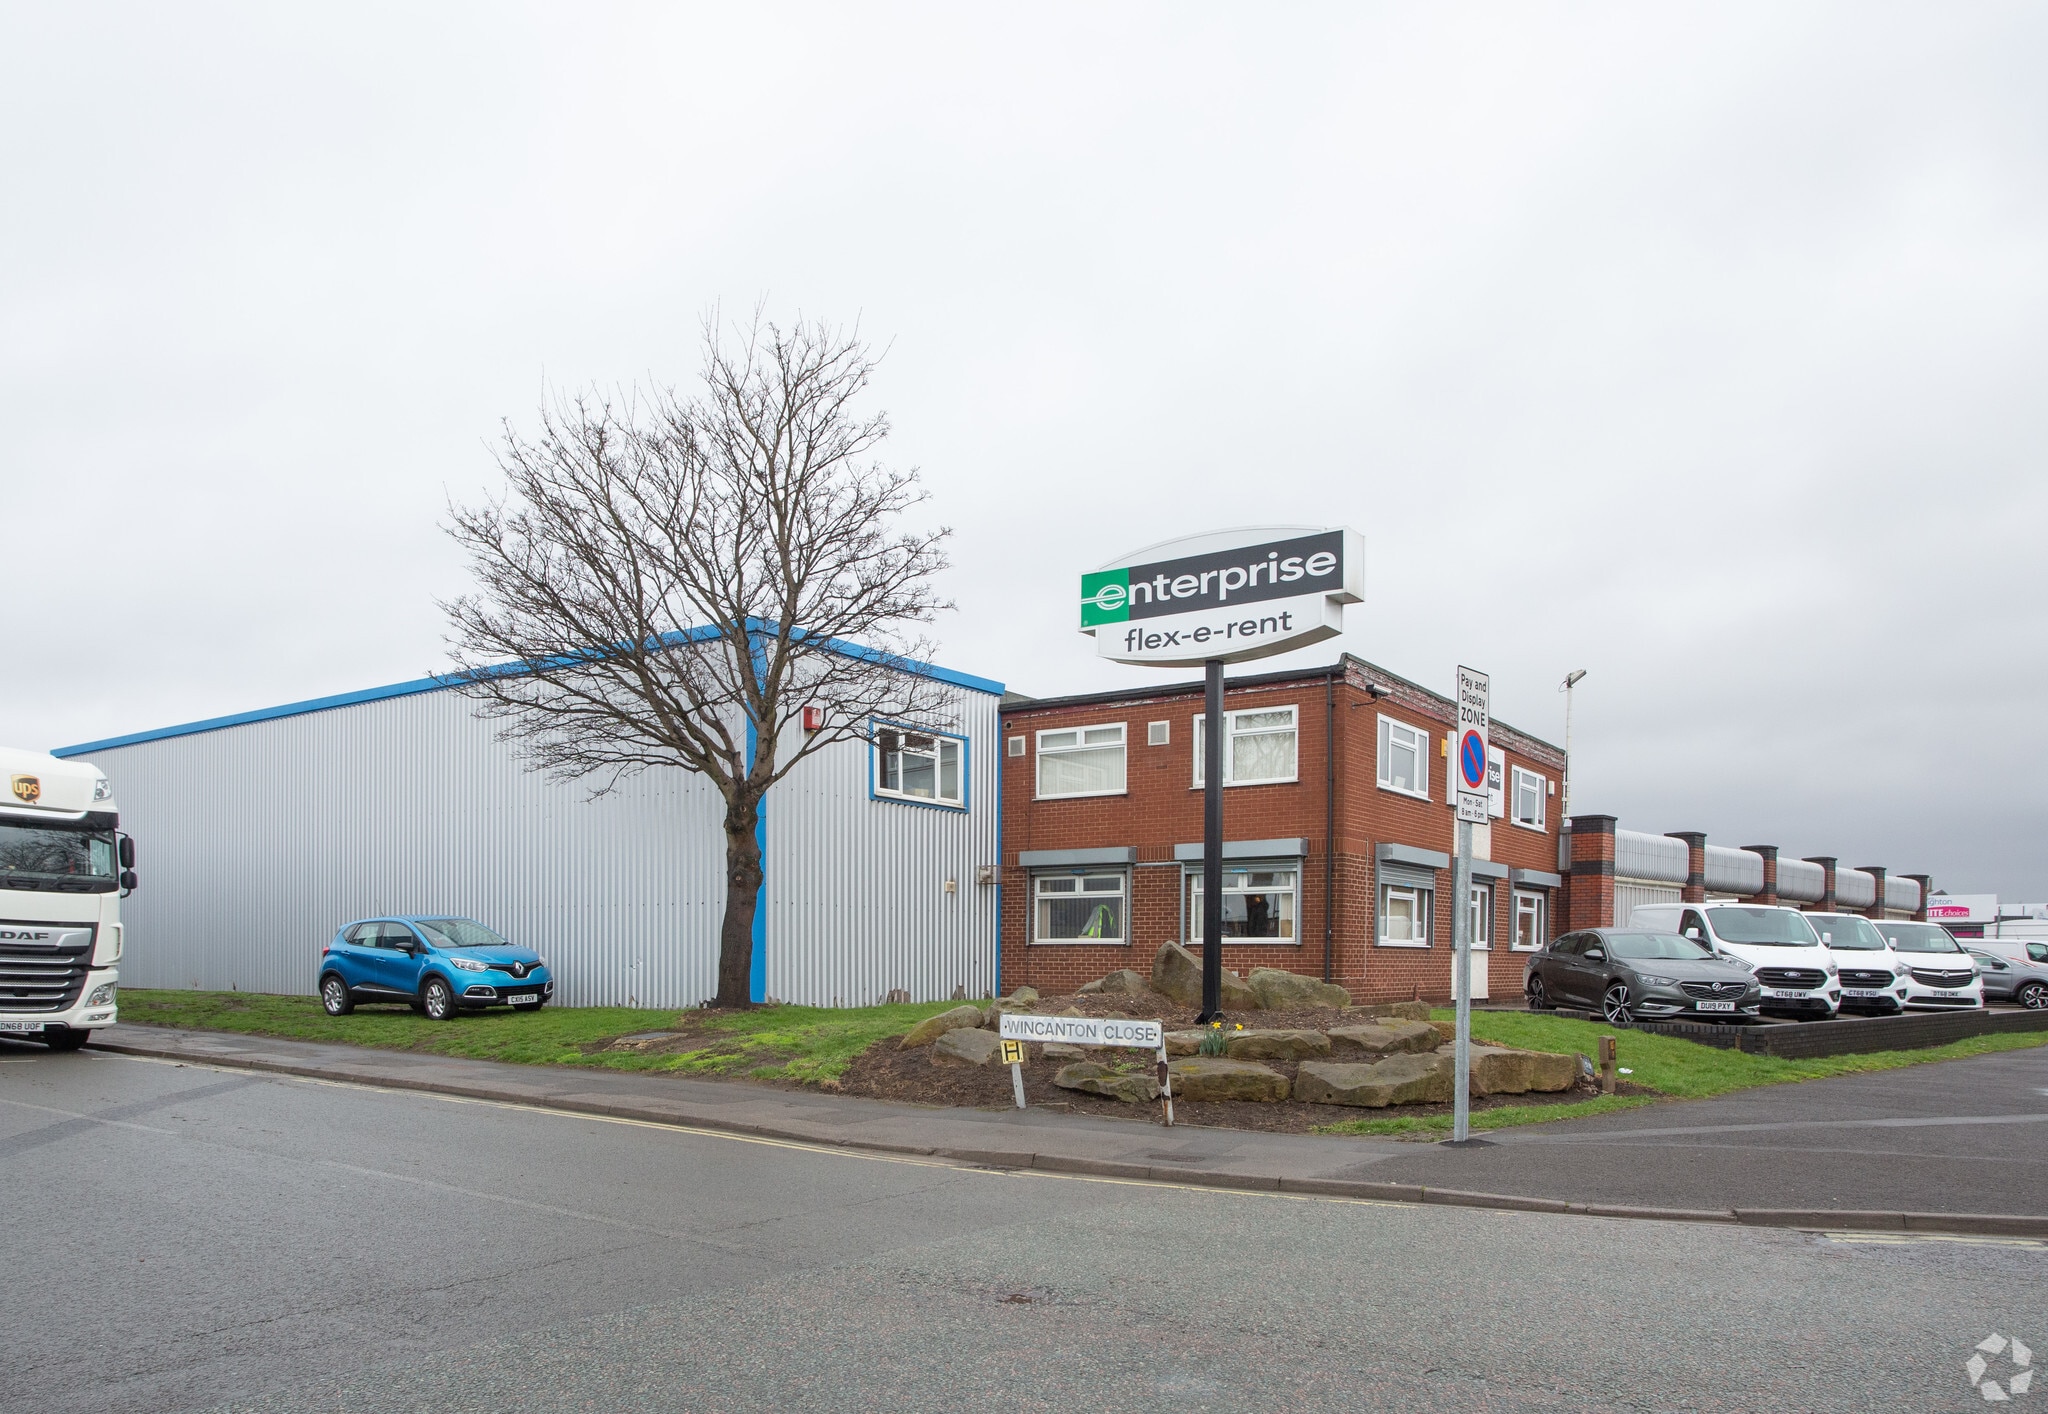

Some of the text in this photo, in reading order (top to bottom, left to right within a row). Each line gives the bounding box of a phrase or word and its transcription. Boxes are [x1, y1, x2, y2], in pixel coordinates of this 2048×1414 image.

[1082, 551, 1338, 610] enterprise
[1124, 610, 1293, 653] flex-e-rent
[1461, 673, 1487, 693] Pay and
[1462, 690, 1486, 710] Display
[1461, 706, 1486, 727] ZONE
[14, 781, 39, 799] ups
[0, 931, 49, 940] DAF
[1700, 1002, 1731, 1010] DU19 PXY
[0, 1022, 42, 1030] DN68 UOF
[1007, 1019, 1154, 1042] WINCANTON CLOSE
